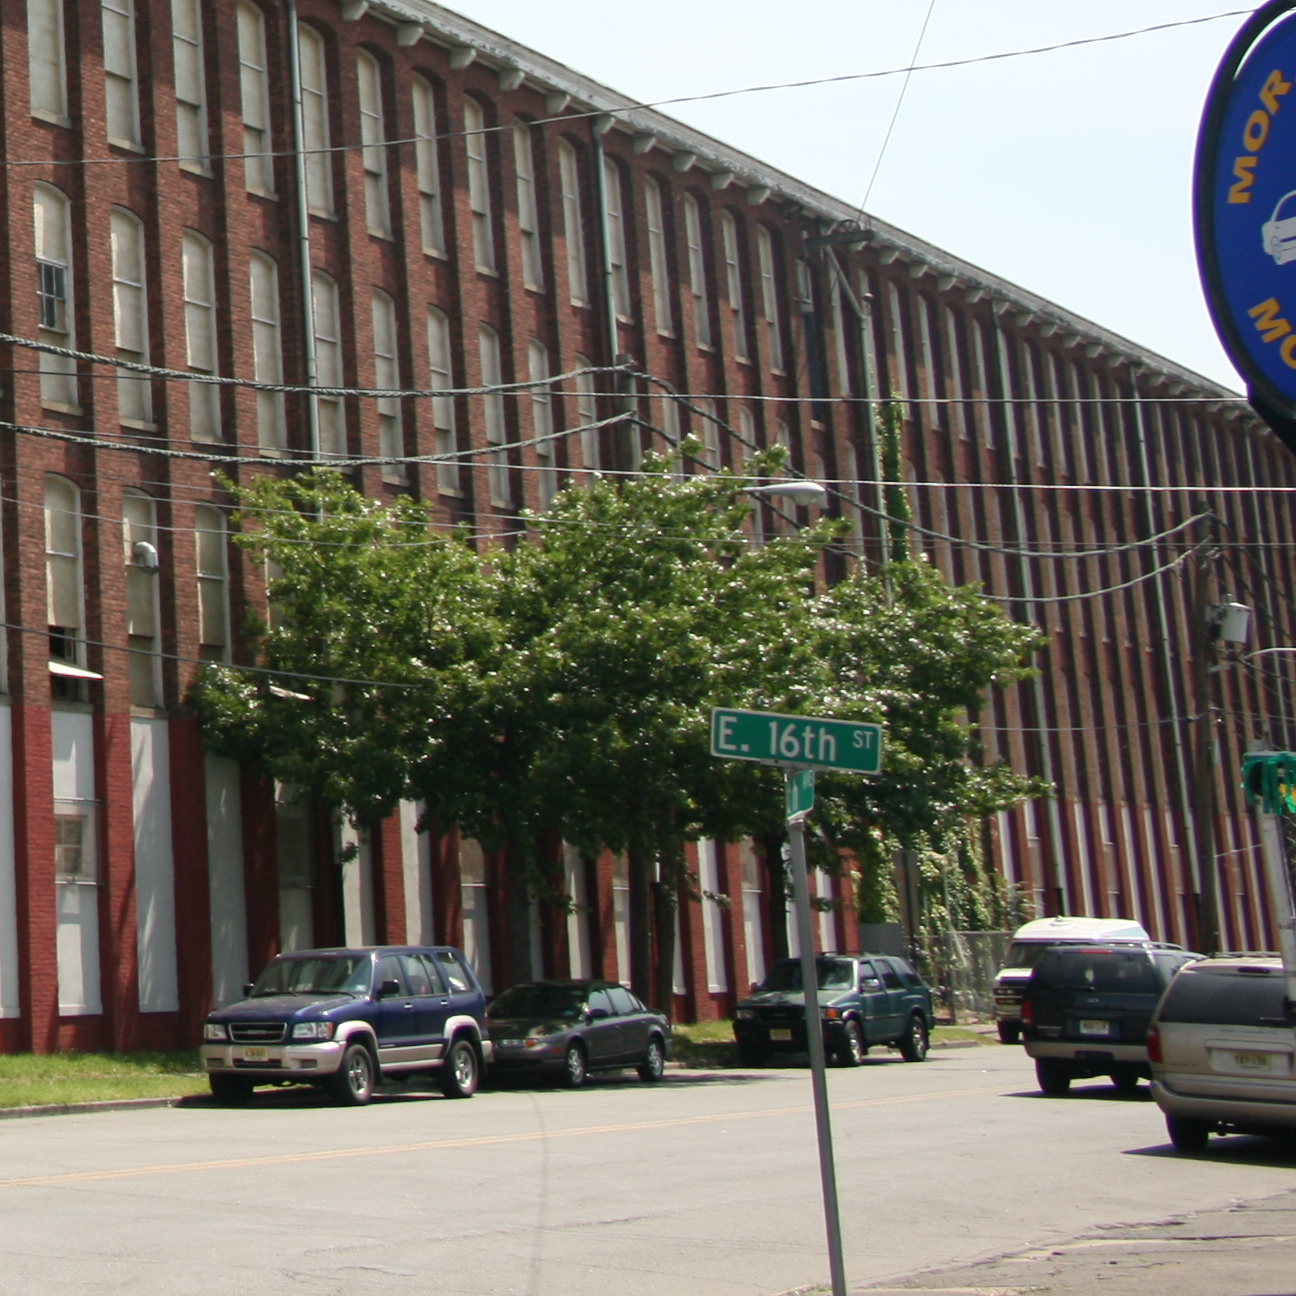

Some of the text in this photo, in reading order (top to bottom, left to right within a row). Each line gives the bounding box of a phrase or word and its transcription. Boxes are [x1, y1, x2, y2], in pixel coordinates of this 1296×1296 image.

[1227, 69, 1296, 204] MOR
[719, 715, 874, 762] E. 16th ST
